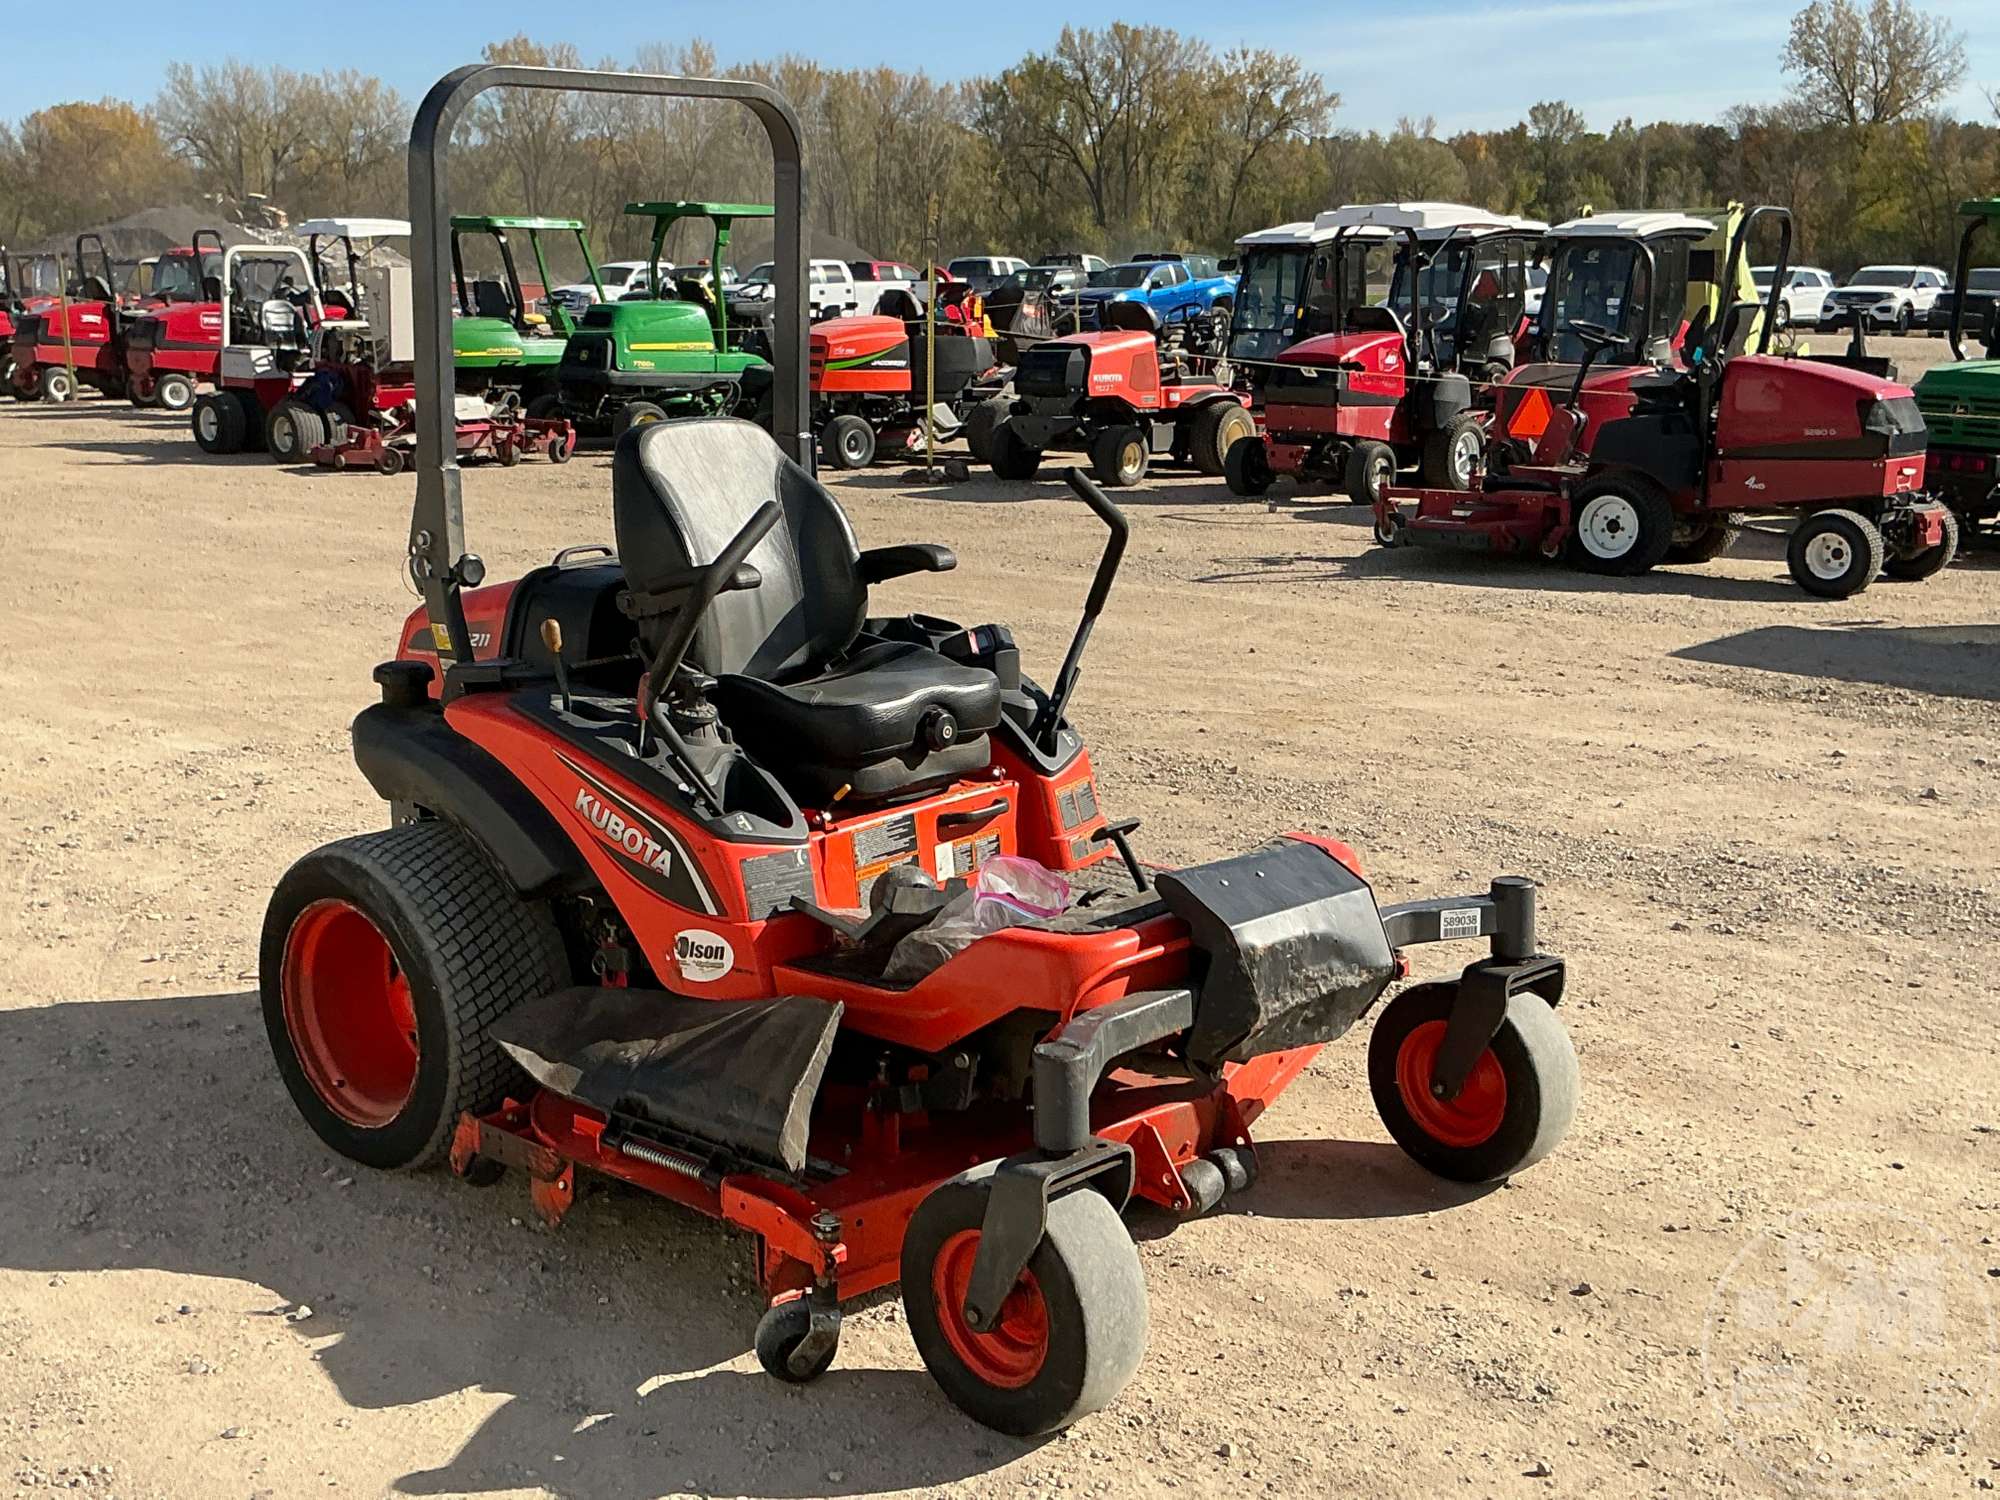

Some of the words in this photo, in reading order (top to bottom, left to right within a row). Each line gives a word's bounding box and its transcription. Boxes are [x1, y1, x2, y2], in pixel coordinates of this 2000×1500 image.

[468, 632, 491, 647] 211
[575, 788, 671, 879] KUBOTA
[1443, 915, 1477, 927] 589038
[677, 936, 725, 961] Olson
